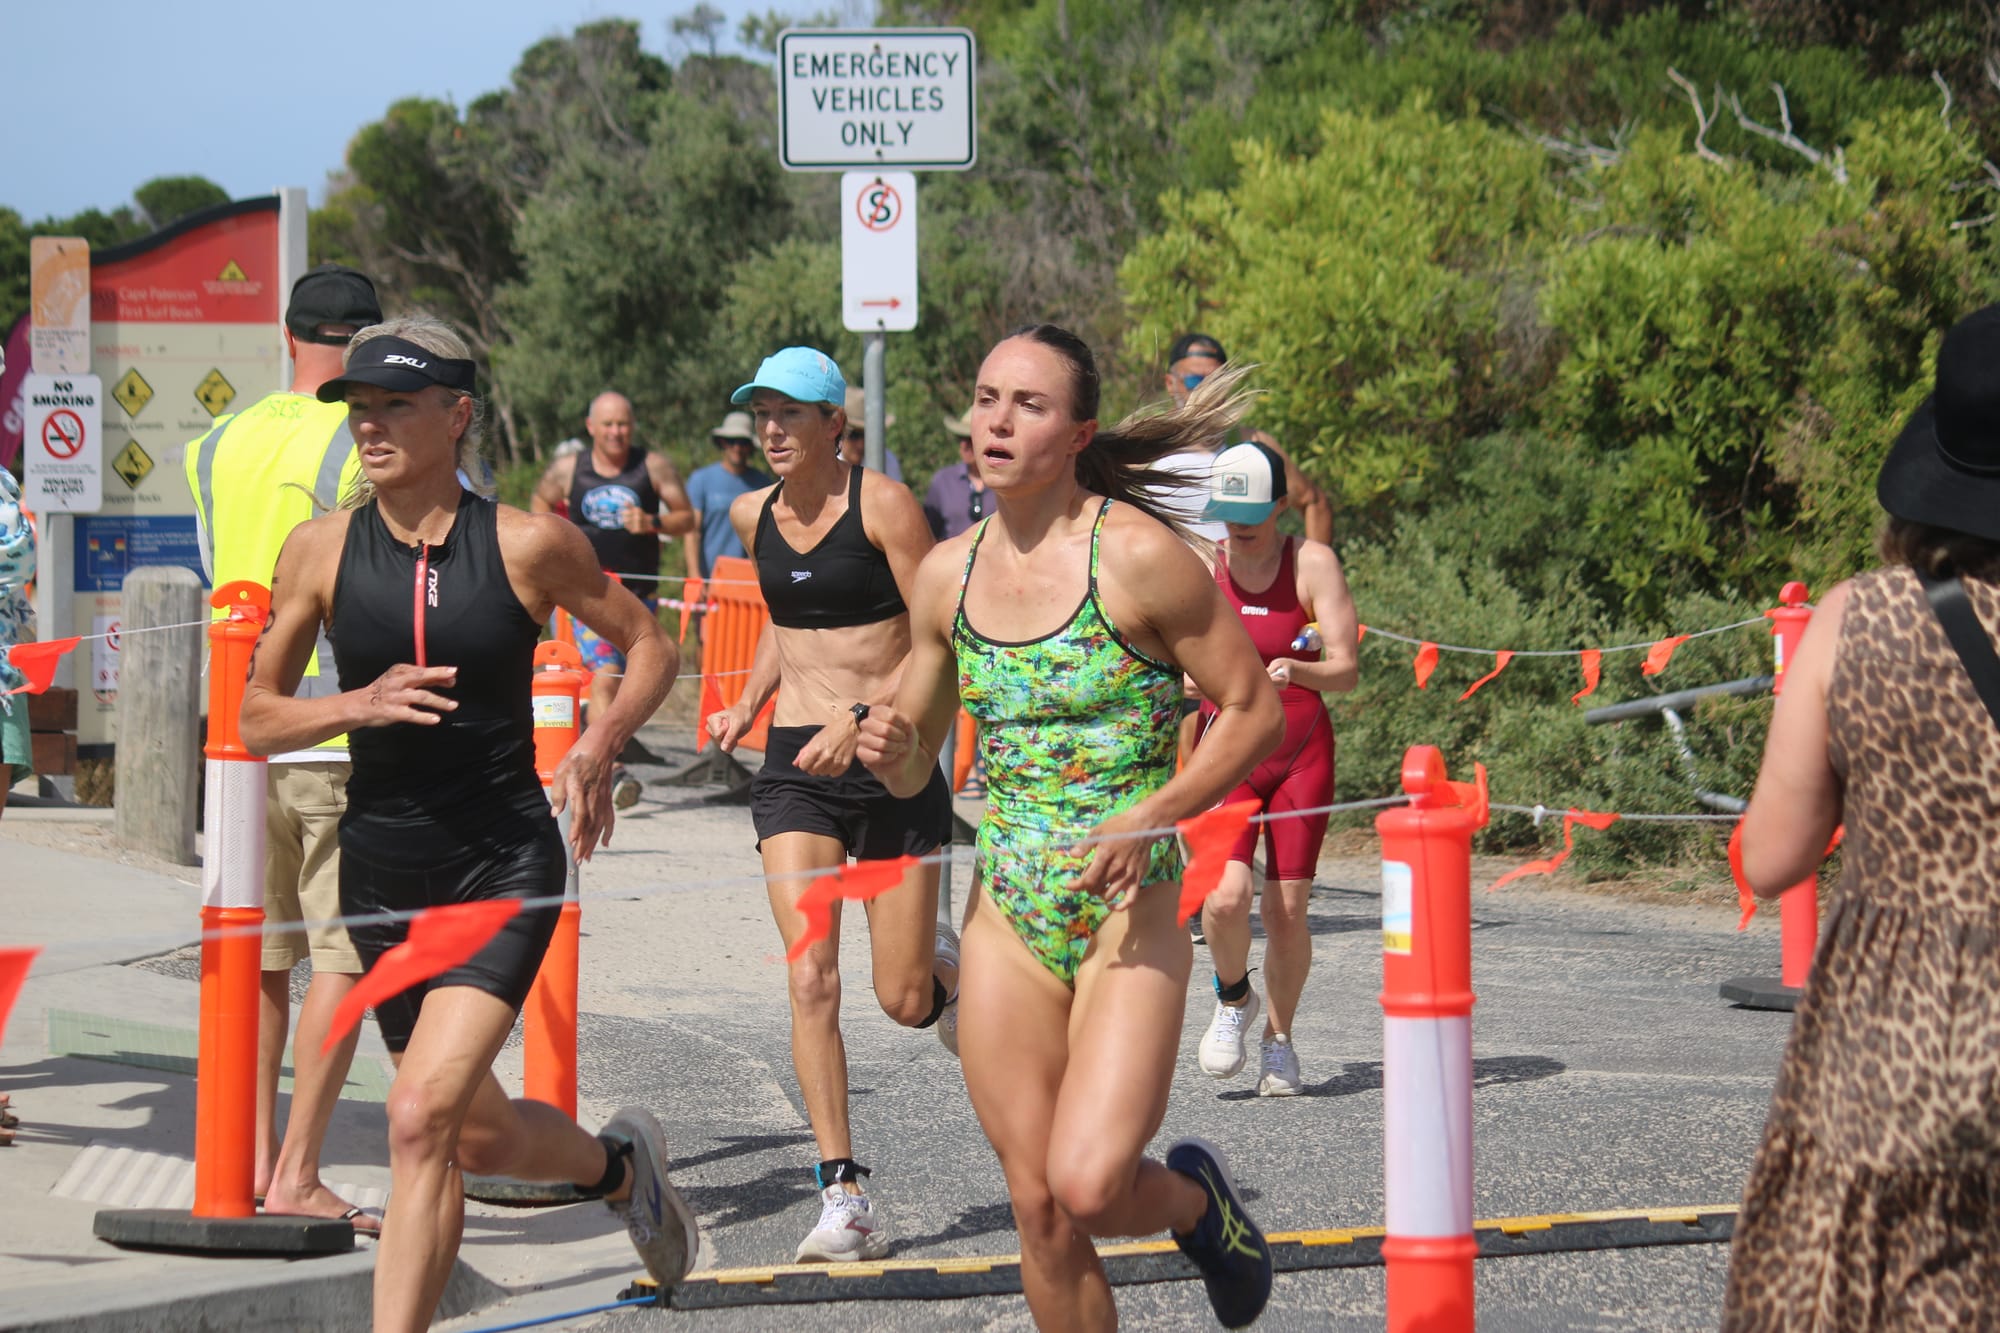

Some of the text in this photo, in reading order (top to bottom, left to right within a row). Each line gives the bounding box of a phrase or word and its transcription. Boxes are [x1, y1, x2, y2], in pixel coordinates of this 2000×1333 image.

[794, 53, 960, 79] EMERGENCY
[812, 87, 944, 111] VEHICLES
[841, 121, 914, 146] ONLY
[119, 287, 147, 302] Cape
[149, 287, 198, 301] Paterson
[119, 305, 203, 319] First Surf Beach
[53, 381, 73, 393] NO
[32, 395, 95, 407] SMOKING
[790, 570, 812, 580] speedo
[1240, 605, 1269, 617] arena
